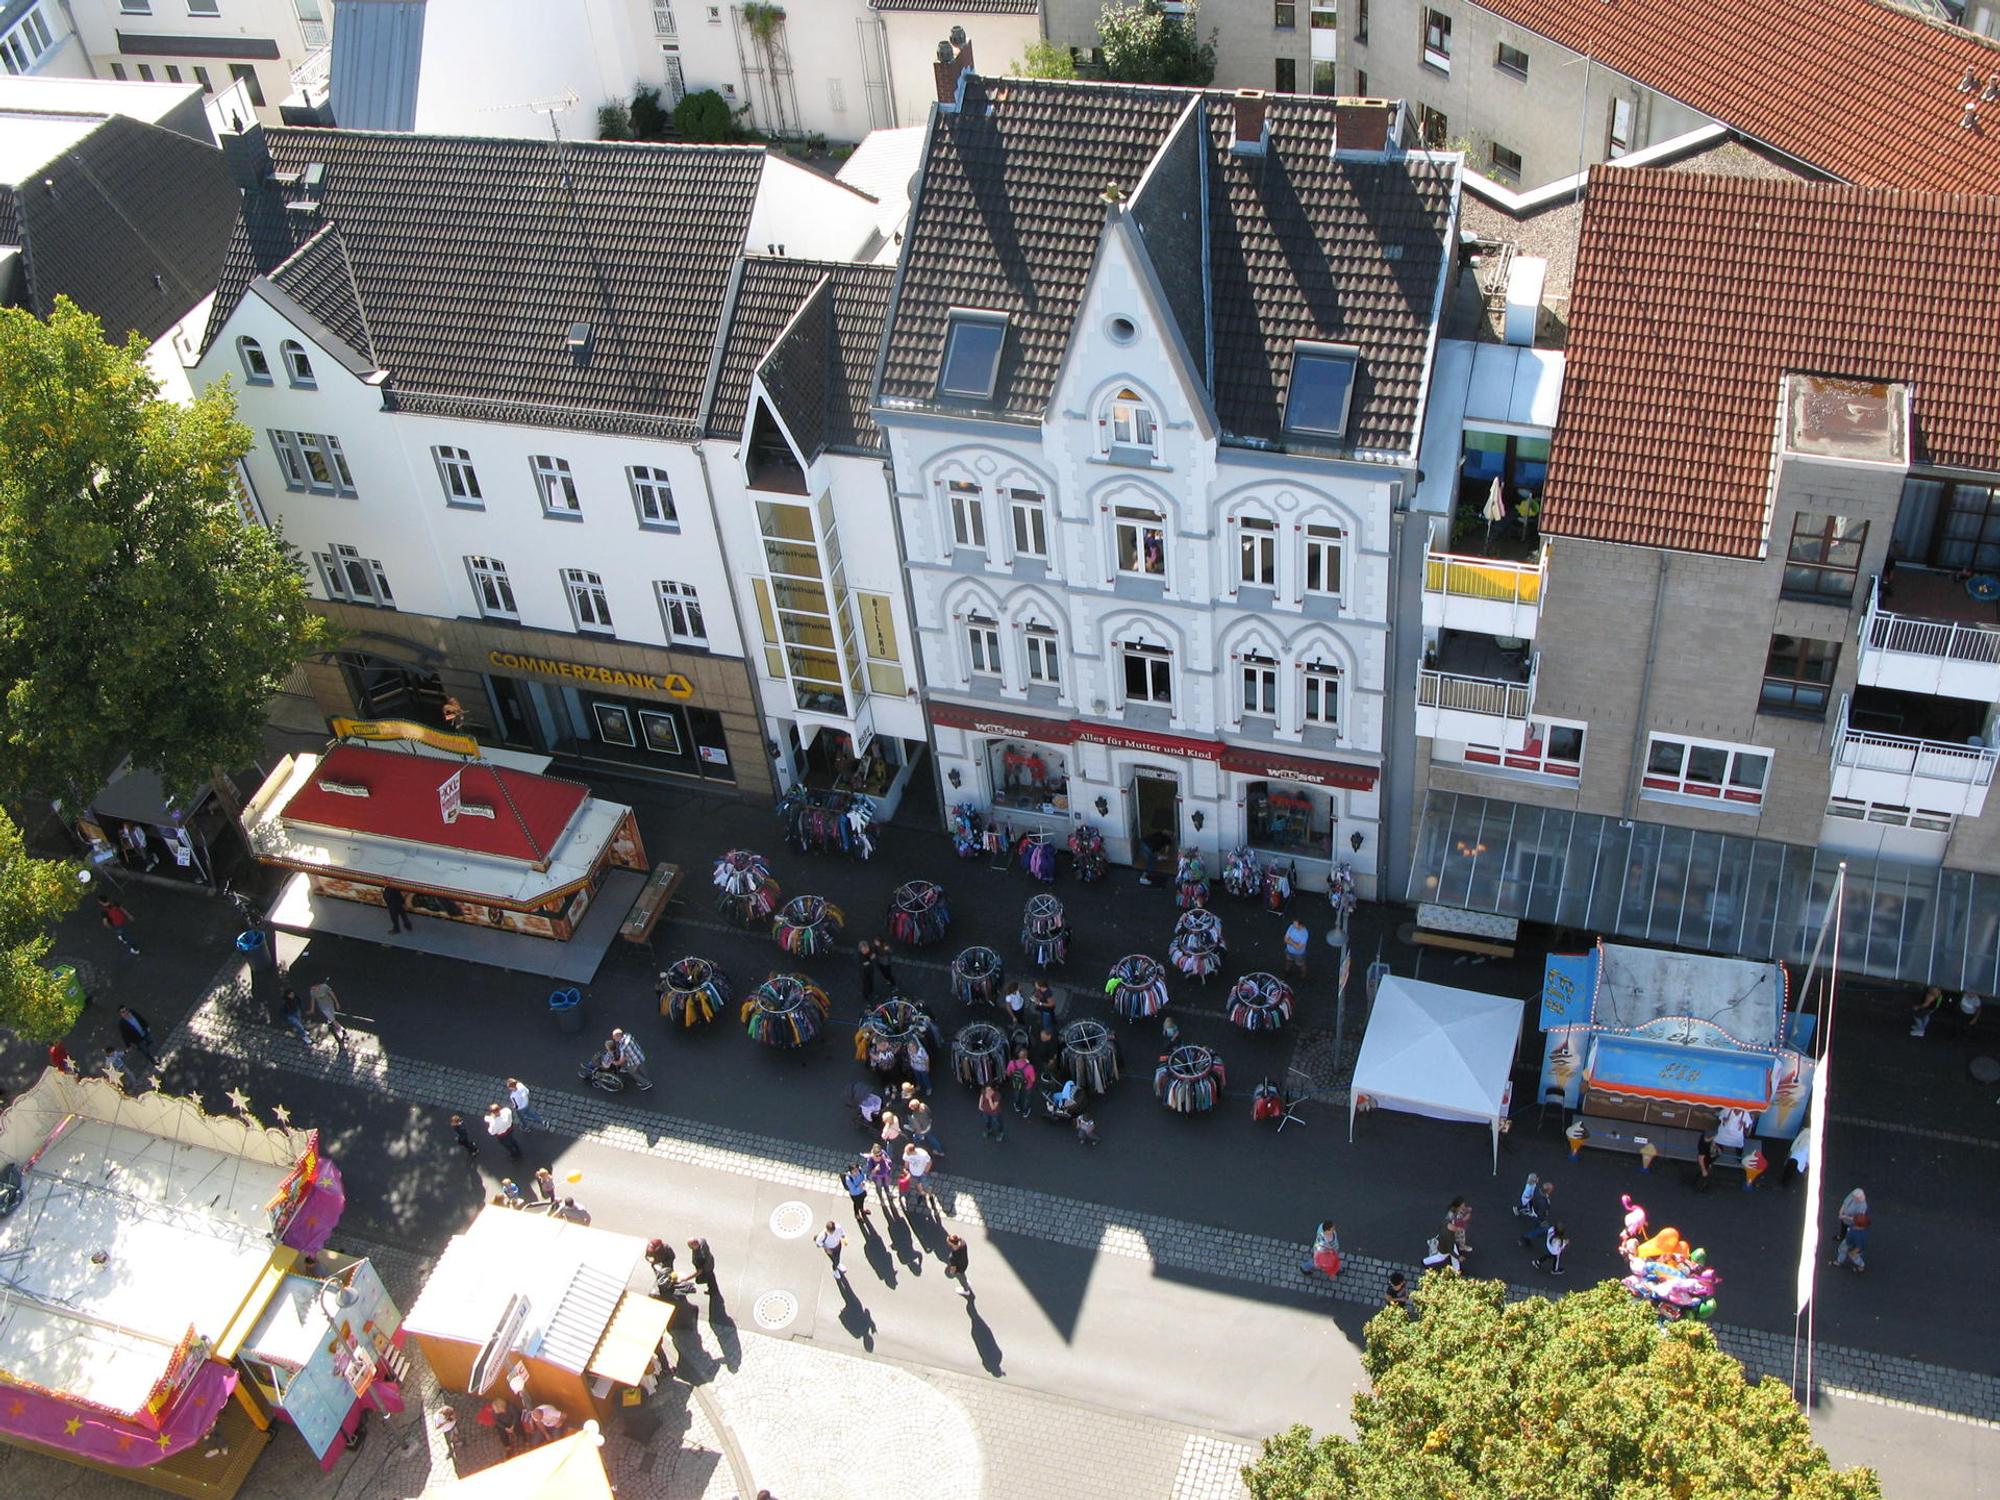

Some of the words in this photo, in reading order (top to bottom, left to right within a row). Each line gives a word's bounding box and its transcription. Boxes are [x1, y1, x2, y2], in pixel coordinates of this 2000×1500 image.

[871, 598, 885, 655] BILLARD
[488, 651, 659, 691] COMMERZBANK
[1079, 733, 1105, 744] Alles
[1107, 736, 1122, 746] für
[1125, 740, 1161, 752] Mutter
[1163, 746, 1184, 756] und
[1187, 749, 1212, 760] Kind
